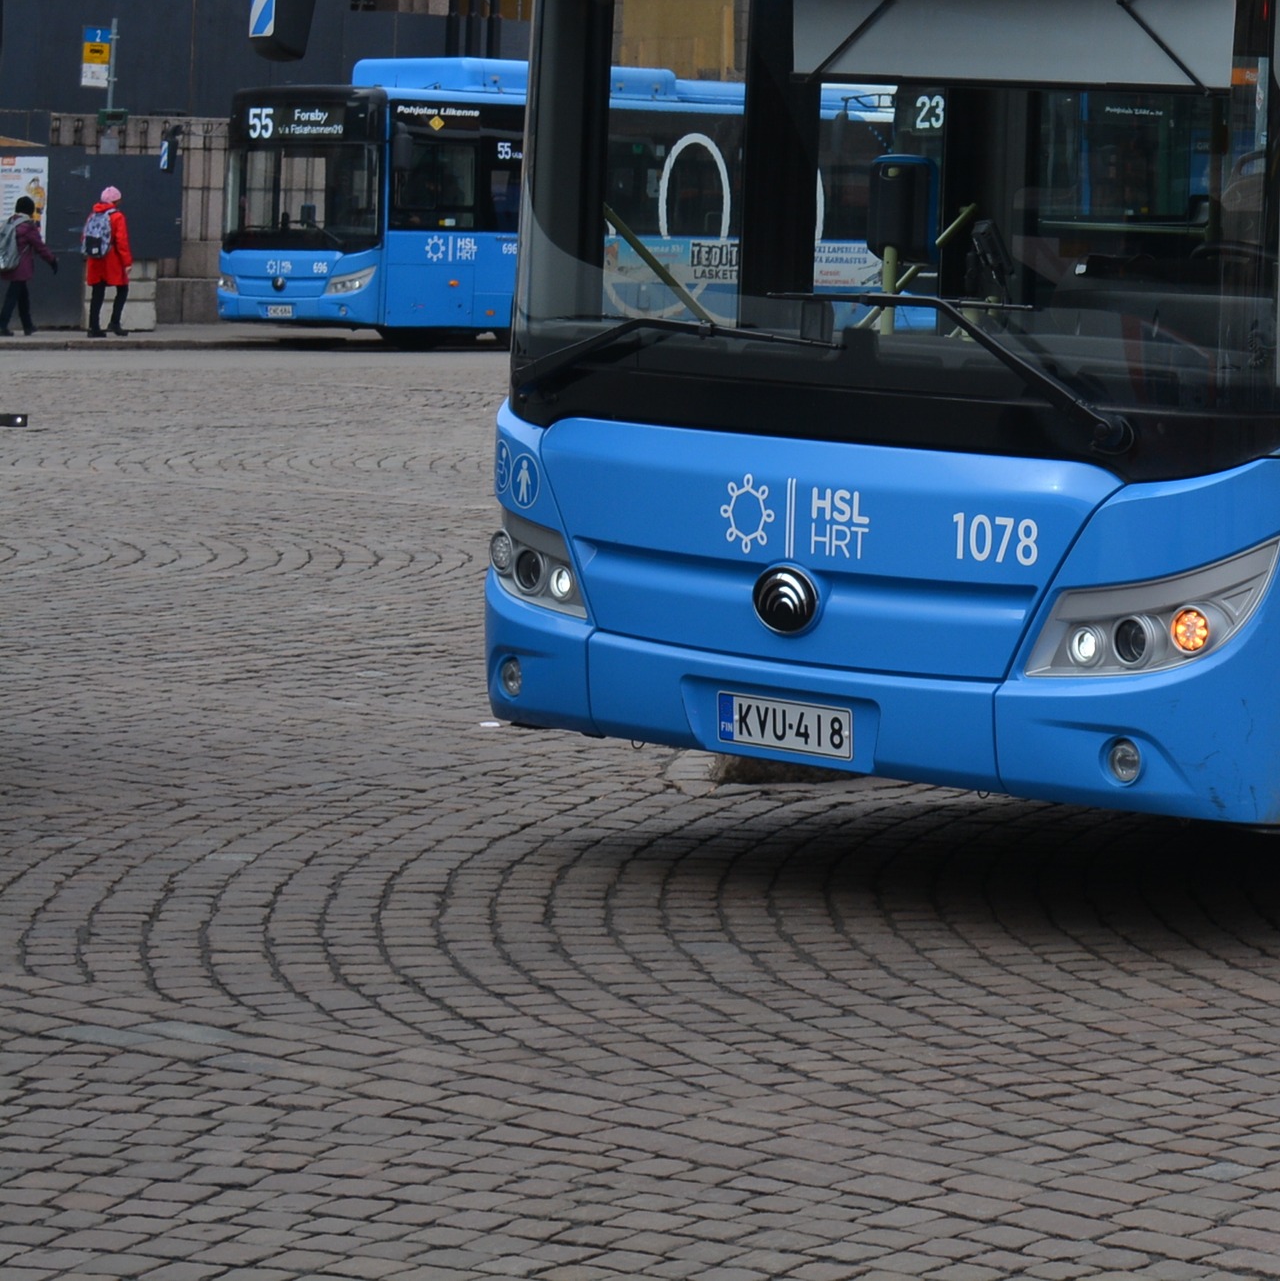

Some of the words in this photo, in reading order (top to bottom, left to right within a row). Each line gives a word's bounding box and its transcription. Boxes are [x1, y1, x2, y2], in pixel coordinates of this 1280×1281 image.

[294, 108, 329, 124] Forsby
[397, 105, 438, 116] Pohjolan
[440, 107, 480, 117] Liikenne
[915, 95, 945, 129] 23
[248, 107, 274, 139] 55
[497, 142, 511, 159] 55
[457, 238, 478, 249] HSL
[502, 243, 518, 255] 696
[456, 249, 477, 261] HRT
[312, 262, 328, 273] 696
[811, 487, 870, 524] HSL
[810, 522, 870, 560] HRT
[952, 512, 1039, 566] 1078
[720, 721, 734, 733] FIN
[738, 703, 844, 750] KVU-418
